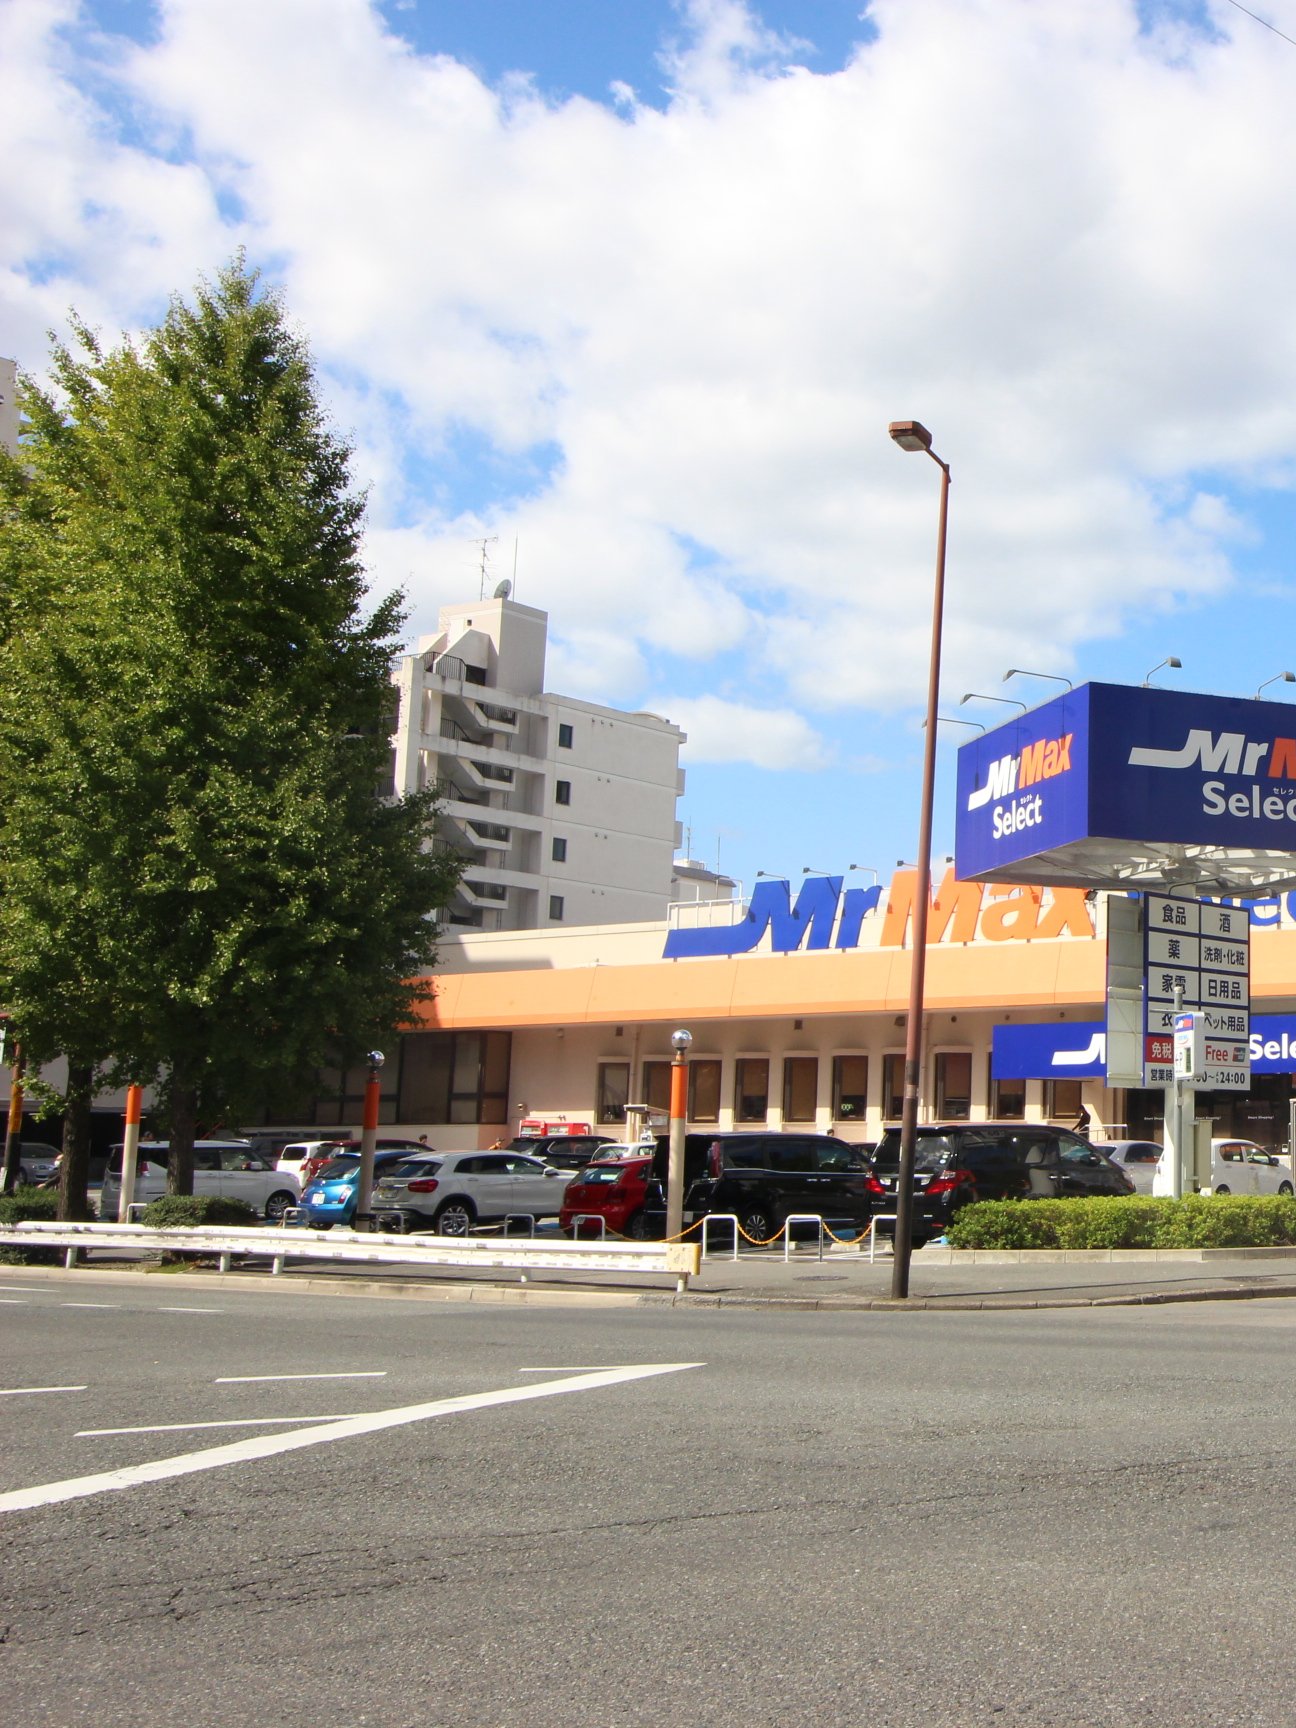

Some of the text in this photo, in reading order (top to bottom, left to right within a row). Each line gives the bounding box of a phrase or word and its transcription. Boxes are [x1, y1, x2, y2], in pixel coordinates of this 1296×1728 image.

[968, 733, 1073, 811] MrMax
[992, 794, 1043, 840] Select
[1162, 904, 1187, 926] 食品
[1219, 913, 1231, 934] 酒
[1168, 939, 1181, 960] 薬
[1208, 979, 1242, 1000] 日用品
[1151, 1042, 1173, 1060] 免税
[1205, 1045, 1229, 1062] Free
[1220, 1071, 1246, 1085] 24:00
